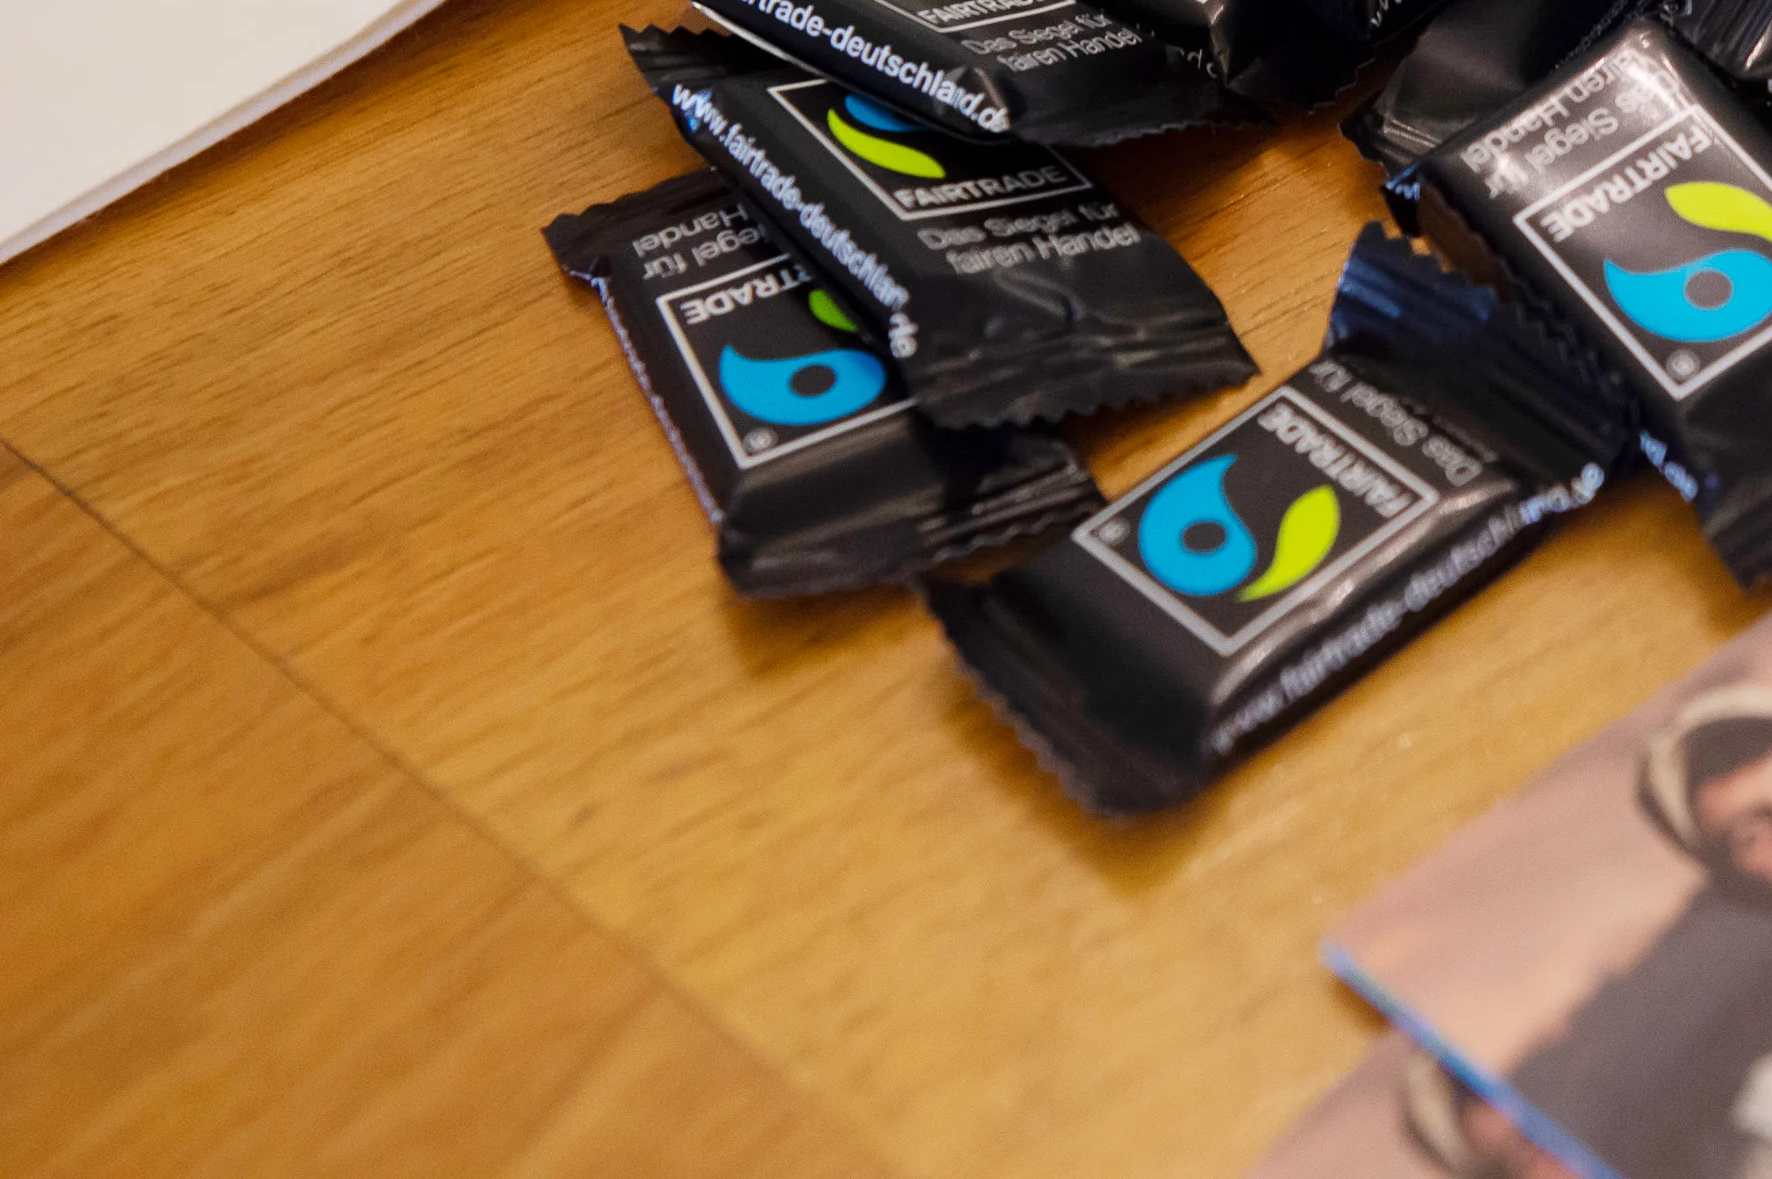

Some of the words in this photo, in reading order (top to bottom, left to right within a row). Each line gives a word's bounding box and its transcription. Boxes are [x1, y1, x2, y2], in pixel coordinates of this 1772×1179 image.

[961, 36, 1017, 54] Das
[1058, 27, 1143, 57] Handel
[894, 165, 1068, 208] FAIRTRADE
[1540, 124, 1712, 242] FAIRTRADE
[632, 202, 749, 258] Handel
[1032, 221, 1141, 259] Handel
[643, 253, 688, 281] für
[1258, 402, 1416, 518] FAIRTRADE
